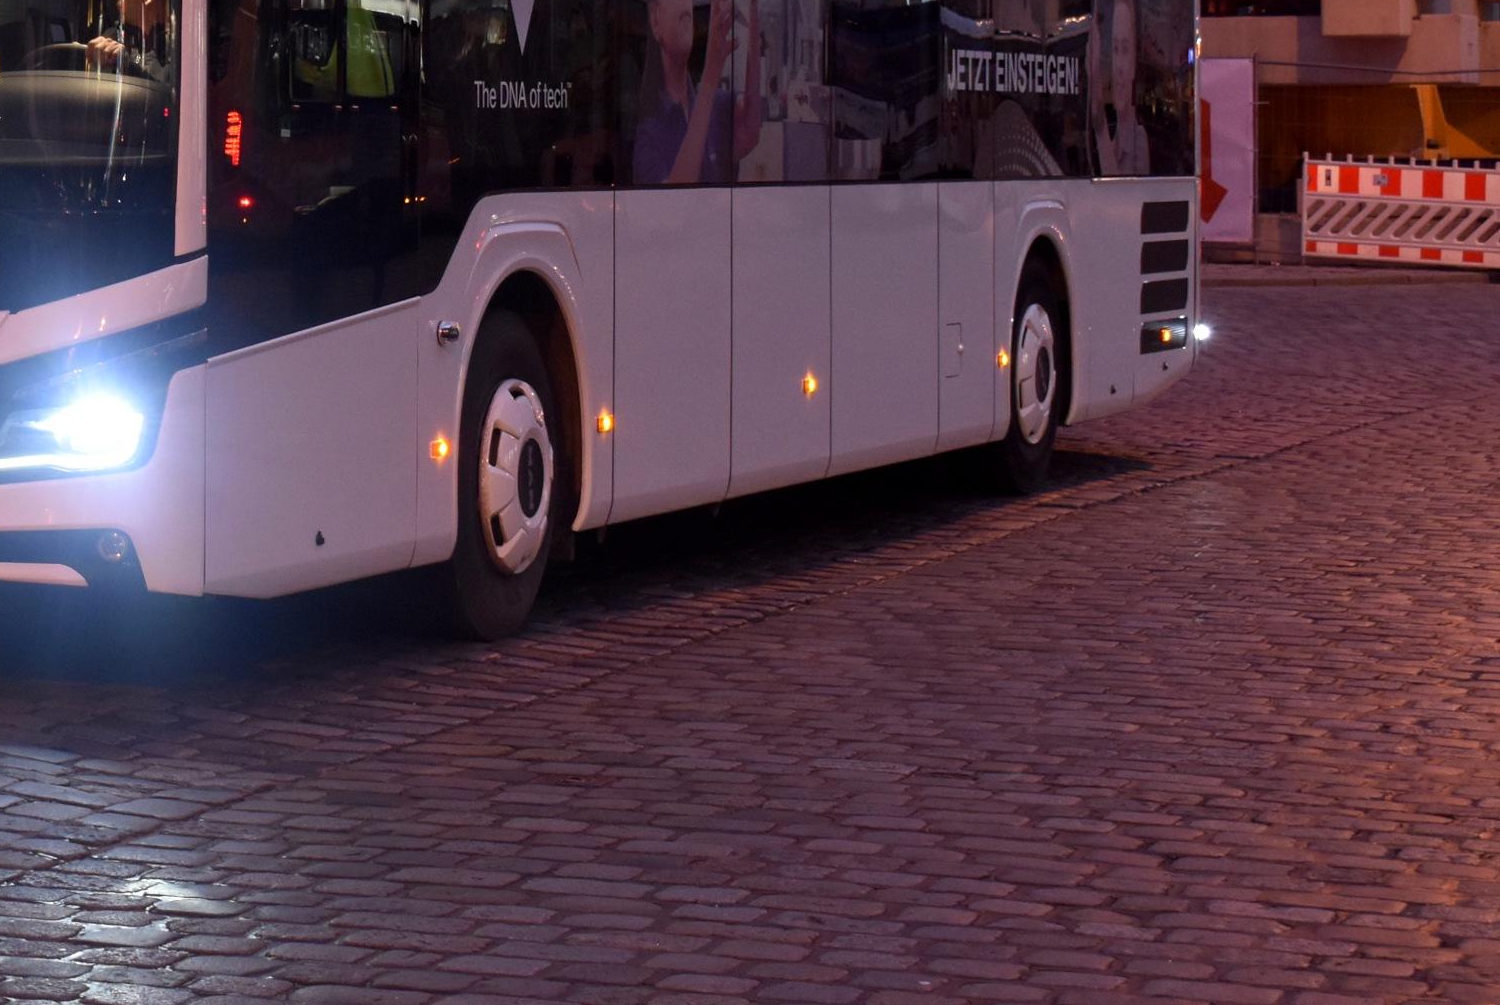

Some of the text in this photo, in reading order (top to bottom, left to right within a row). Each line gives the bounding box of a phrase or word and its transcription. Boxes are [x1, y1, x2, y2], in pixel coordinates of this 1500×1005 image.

[947, 50, 1079, 95] JETZT EINSTEIGEN!
[474, 81, 496, 109] The
[499, 82, 526, 109] DNA
[530, 82, 542, 109] of
